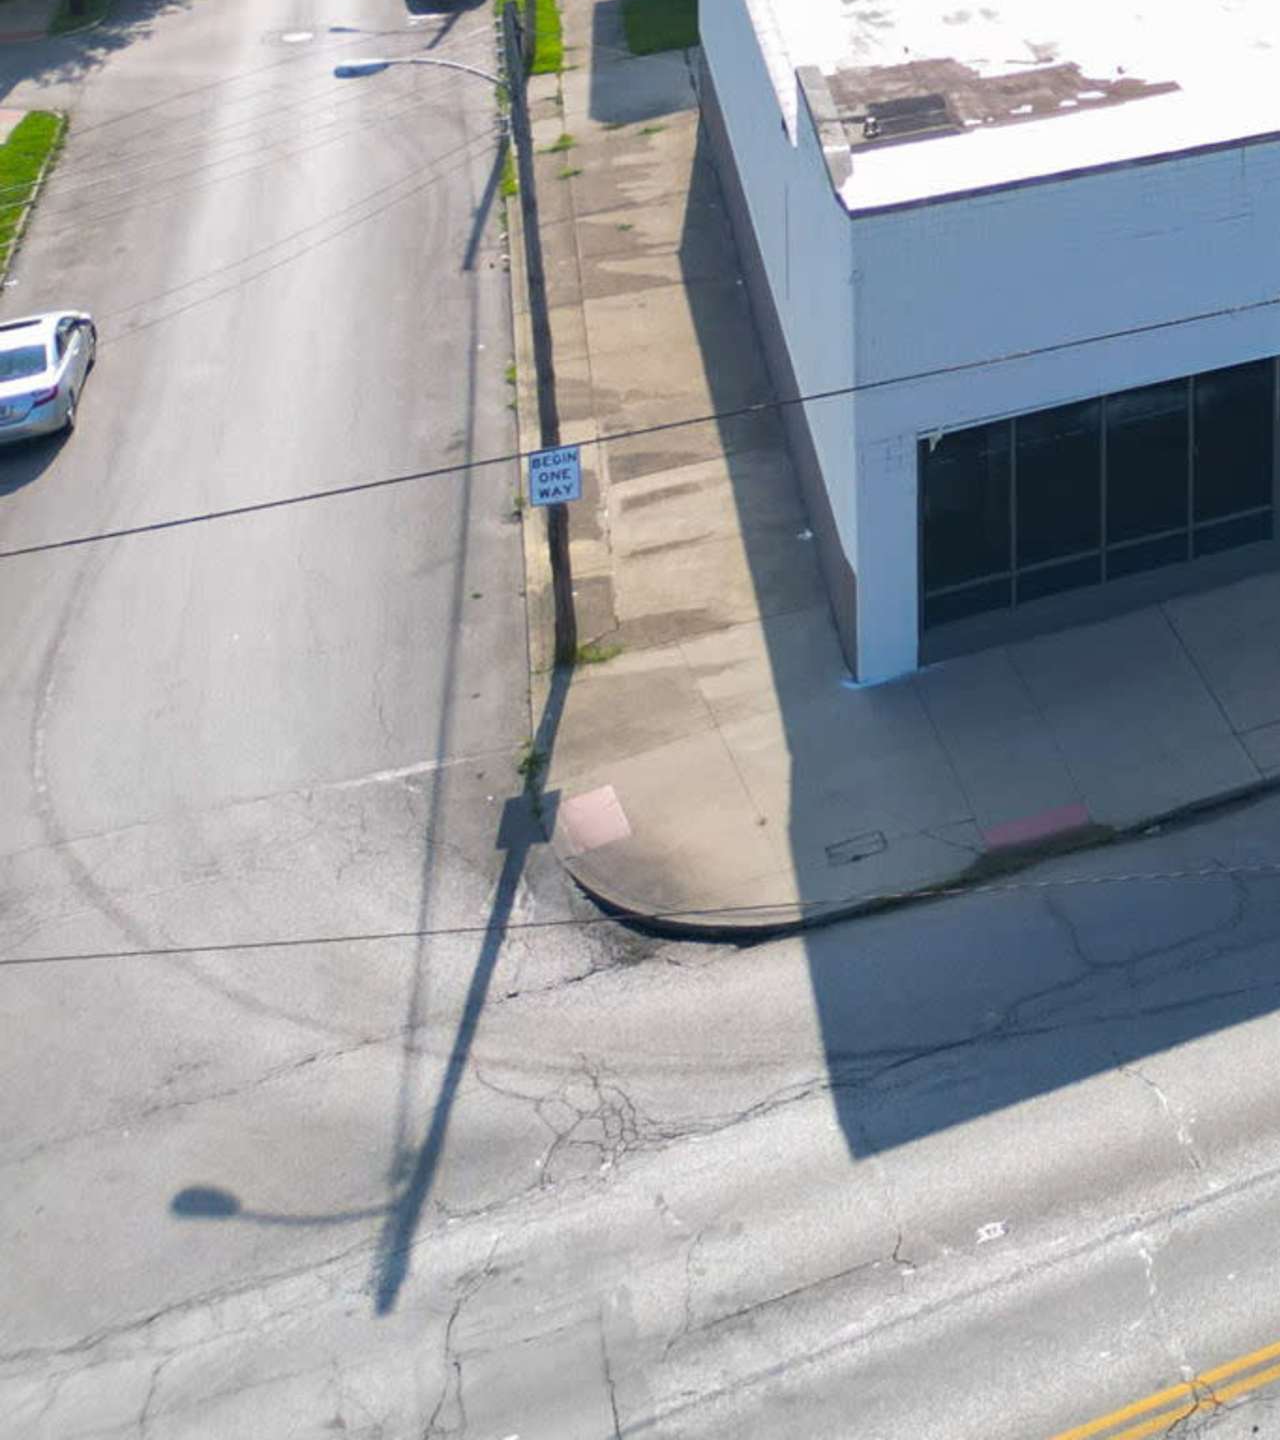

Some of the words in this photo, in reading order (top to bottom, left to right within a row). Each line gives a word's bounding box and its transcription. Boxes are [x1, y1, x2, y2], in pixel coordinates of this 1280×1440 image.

[532, 451, 577, 469] BEGIN
[539, 468, 572, 482] ONE
[540, 483, 574, 498] WAY
